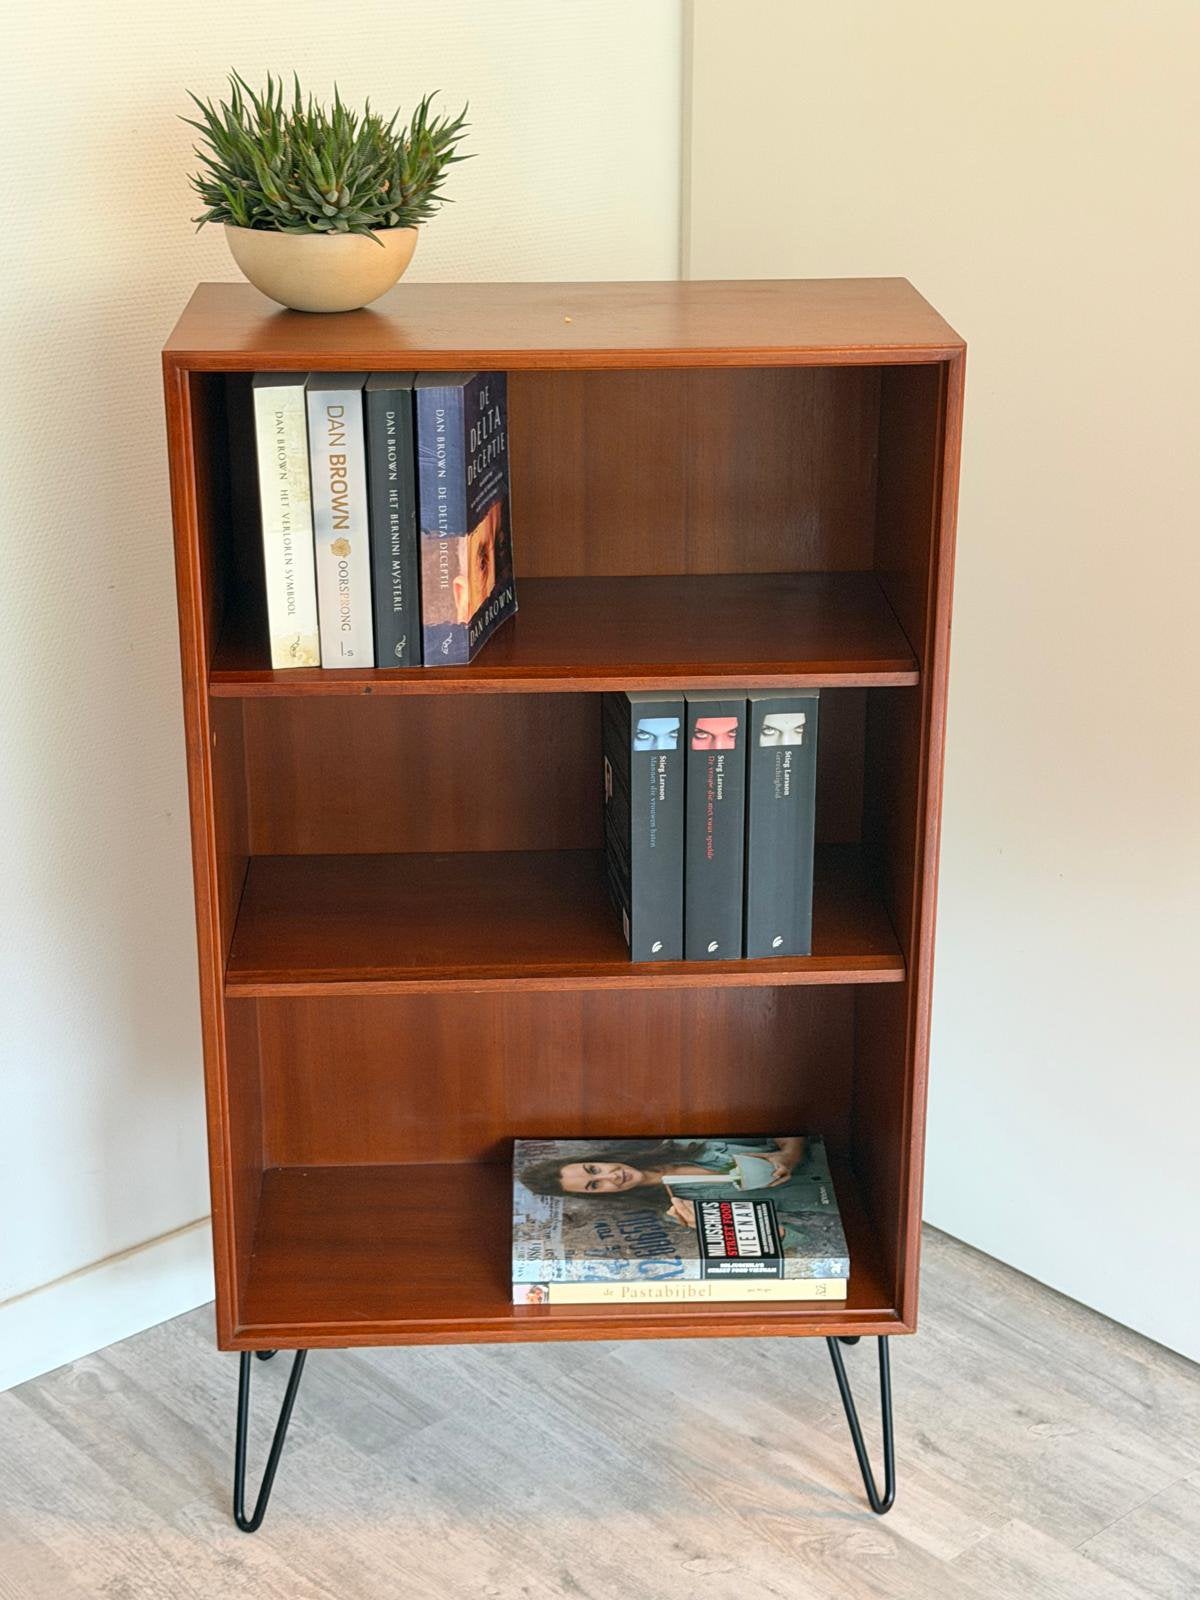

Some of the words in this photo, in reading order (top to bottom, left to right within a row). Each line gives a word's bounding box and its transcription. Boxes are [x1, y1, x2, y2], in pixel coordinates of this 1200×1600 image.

[480, 386, 489, 410] DE
[274, 411, 285, 434] DAN
[326, 405, 346, 447] DAN
[386, 411, 396, 435] DAN
[435, 409, 446, 432] DAN
[470, 405, 501, 453] DELTA
[276, 439, 288, 480] BROWN
[387, 439, 398, 480] BROWN
[436, 437, 447, 478] BROWN
[467, 432, 505, 486] DECEPTIE
[280, 489, 290, 507] HET
[329, 454, 350, 530] BROWN
[389, 489, 399, 509] HET
[438, 487, 447, 500] DE
[390, 514, 401, 555] BERNINI
[438, 505, 448, 538] DELTA
[282, 512, 293, 565] VERLOREN
[439, 542, 449, 590] DECEPTIE
[284, 569, 296, 616] SYMBOOL
[338, 560, 352, 632] OORSPRONG
[391, 560, 403, 613] MYSTERIE
[470, 620, 484, 647] DAN
[484, 586, 513, 626] BROWN
[657, 755, 667, 773] Stieg
[715, 755, 725, 773] Stieg
[773, 751, 782, 799] Gerechtigheid
[782, 751, 793, 768] Stieg
[658, 774, 667, 800] Larsson
[717, 774, 725, 800] Larsson
[784, 769, 793, 796] Larsson
[720, 1202, 734, 1225] FOOD
[733, 1202, 759, 1255] VIETNAM
[724, 1226, 737, 1257] STREET
[603, 1288, 614, 1297] de
[621, 1284, 712, 1299] Pastabijbel
